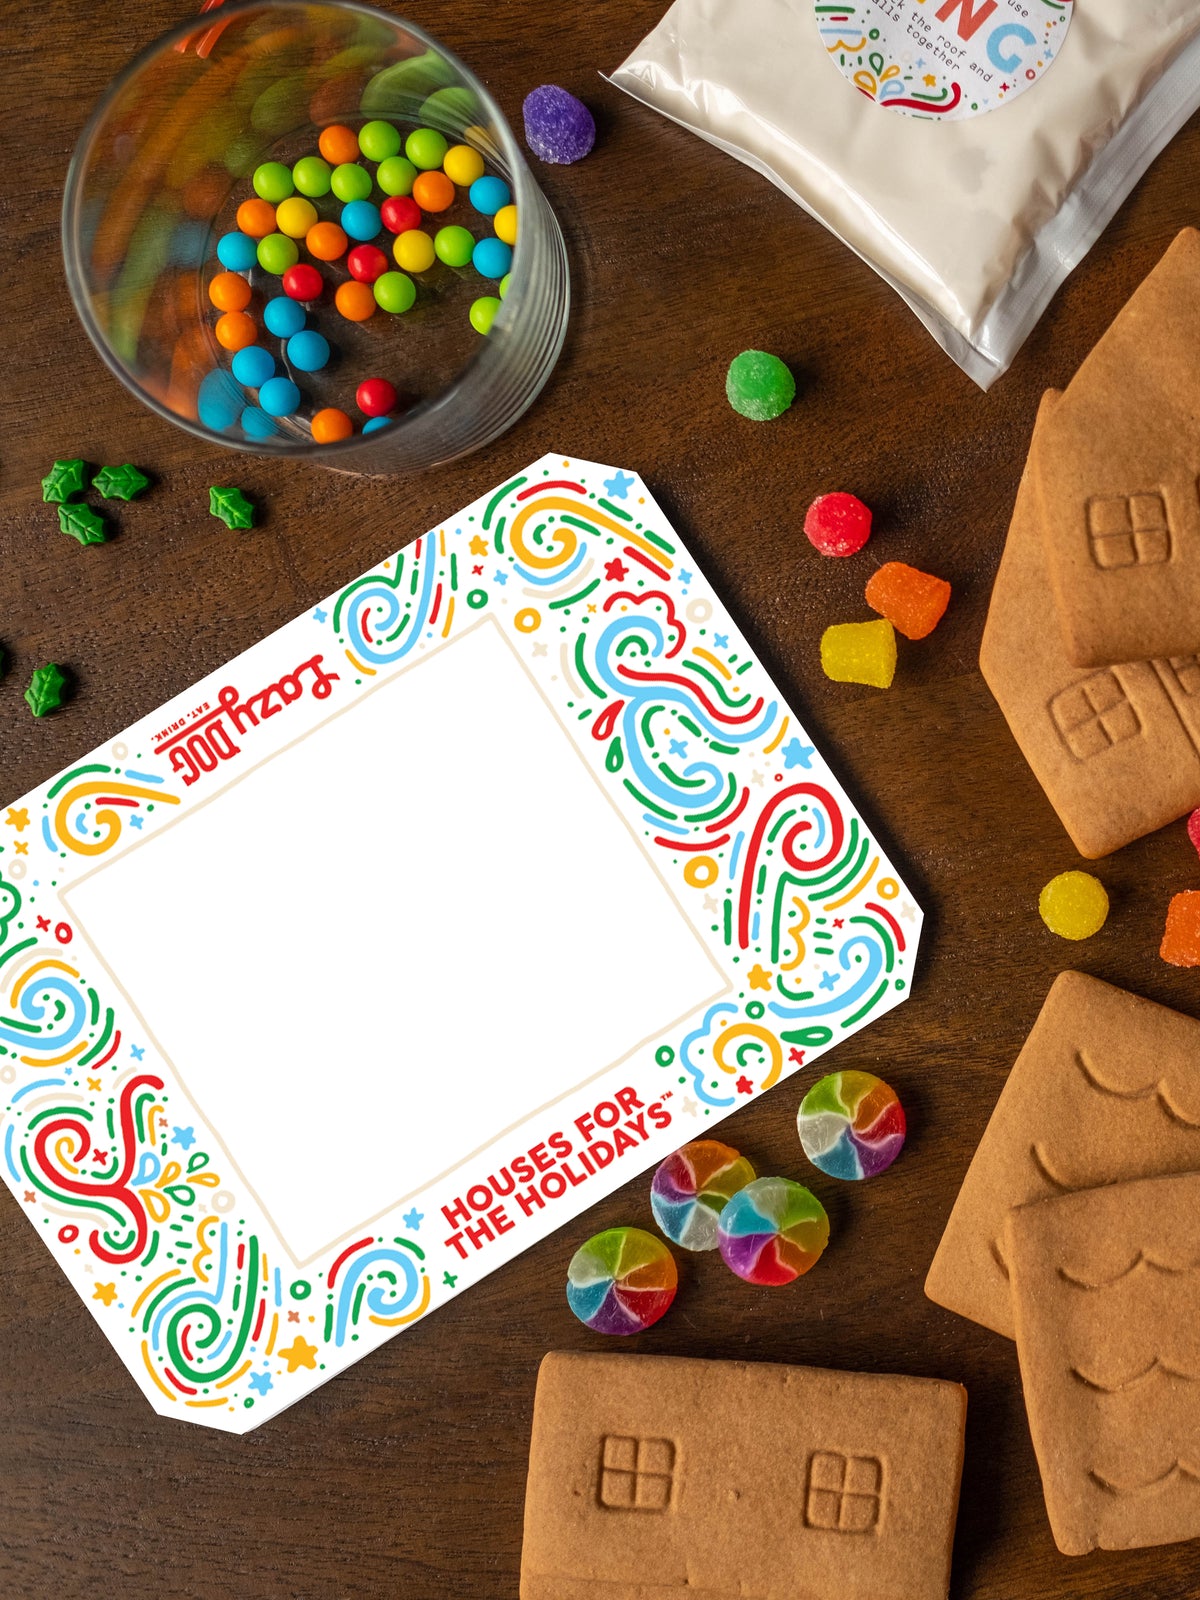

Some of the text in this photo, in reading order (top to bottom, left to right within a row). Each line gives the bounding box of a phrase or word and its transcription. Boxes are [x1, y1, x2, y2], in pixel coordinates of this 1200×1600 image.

[906, 24, 960, 71] together
[911, 11, 994, 83] the roof and
[915, 0, 1038, 74] NG
[150, 701, 211, 742] EAT. DRINK.
[214, 654, 341, 737] Lazy
[168, 719, 241, 787] DOG
[440, 1086, 645, 1230] HOUSES FOR
[444, 1204, 516, 1260] THE
